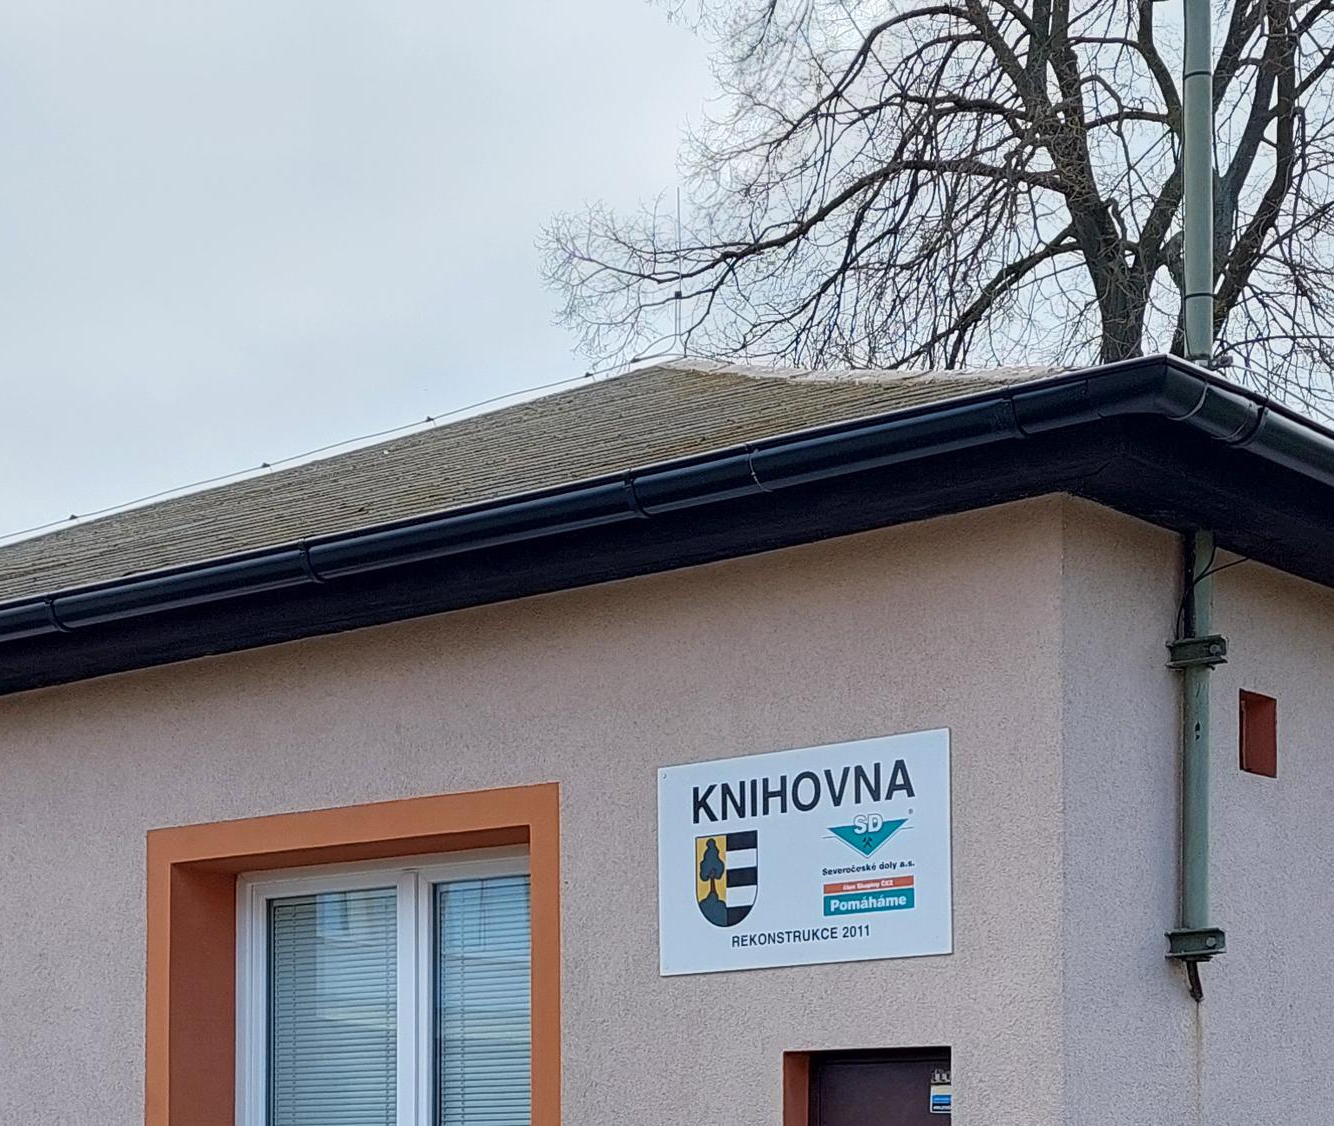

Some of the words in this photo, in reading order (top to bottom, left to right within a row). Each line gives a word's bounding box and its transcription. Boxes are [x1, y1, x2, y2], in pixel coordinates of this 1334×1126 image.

[693, 759, 915, 824] KNIHOVNA
[853, 812, 884, 835] SD
[822, 863, 876, 876] Severočeské
[879, 861, 897, 870] doly
[899, 860, 915, 868] a.s.
[830, 895, 907, 912] Pomáháme
[732, 927, 838, 948] REKONSTRUKCE
[842, 924, 870, 939] 2011
